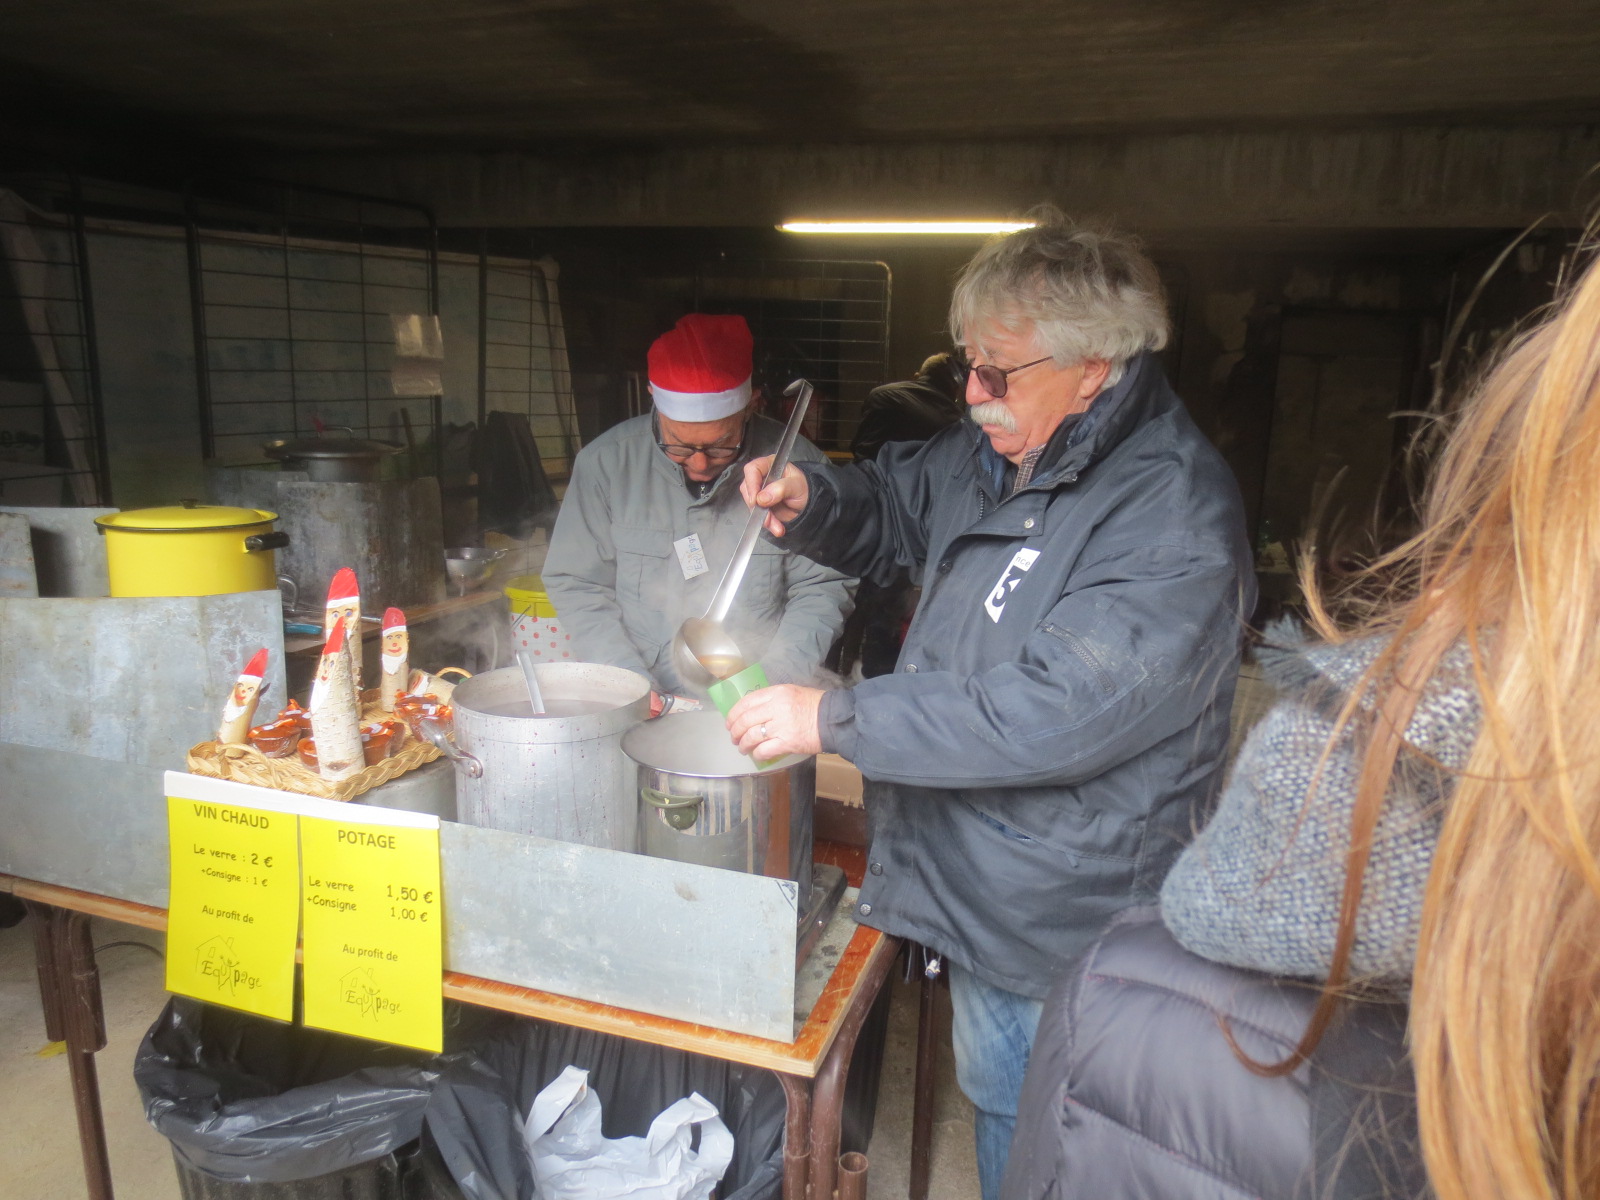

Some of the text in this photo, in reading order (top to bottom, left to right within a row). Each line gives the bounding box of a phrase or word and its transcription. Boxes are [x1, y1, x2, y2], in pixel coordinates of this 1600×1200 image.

[1015, 556, 1031, 568] nce
[193, 803, 269, 829] VIN CHAUD
[338, 829, 396, 849] POTAGE
[193, 843, 206, 855] Le
[209, 849, 237, 861] verre
[251, 853, 259, 865] 2
[264, 856, 273, 868] €
[201, 867, 242, 882] +Consigne
[253, 877, 257, 885] 1
[261, 879, 268, 887] €
[308, 875, 433, 904] Le verre 1,50 €
[202, 904, 254, 924] Au profit de
[307, 895, 428, 923] +Consigne 1,00 €
[342, 943, 398, 962] Au profit de
